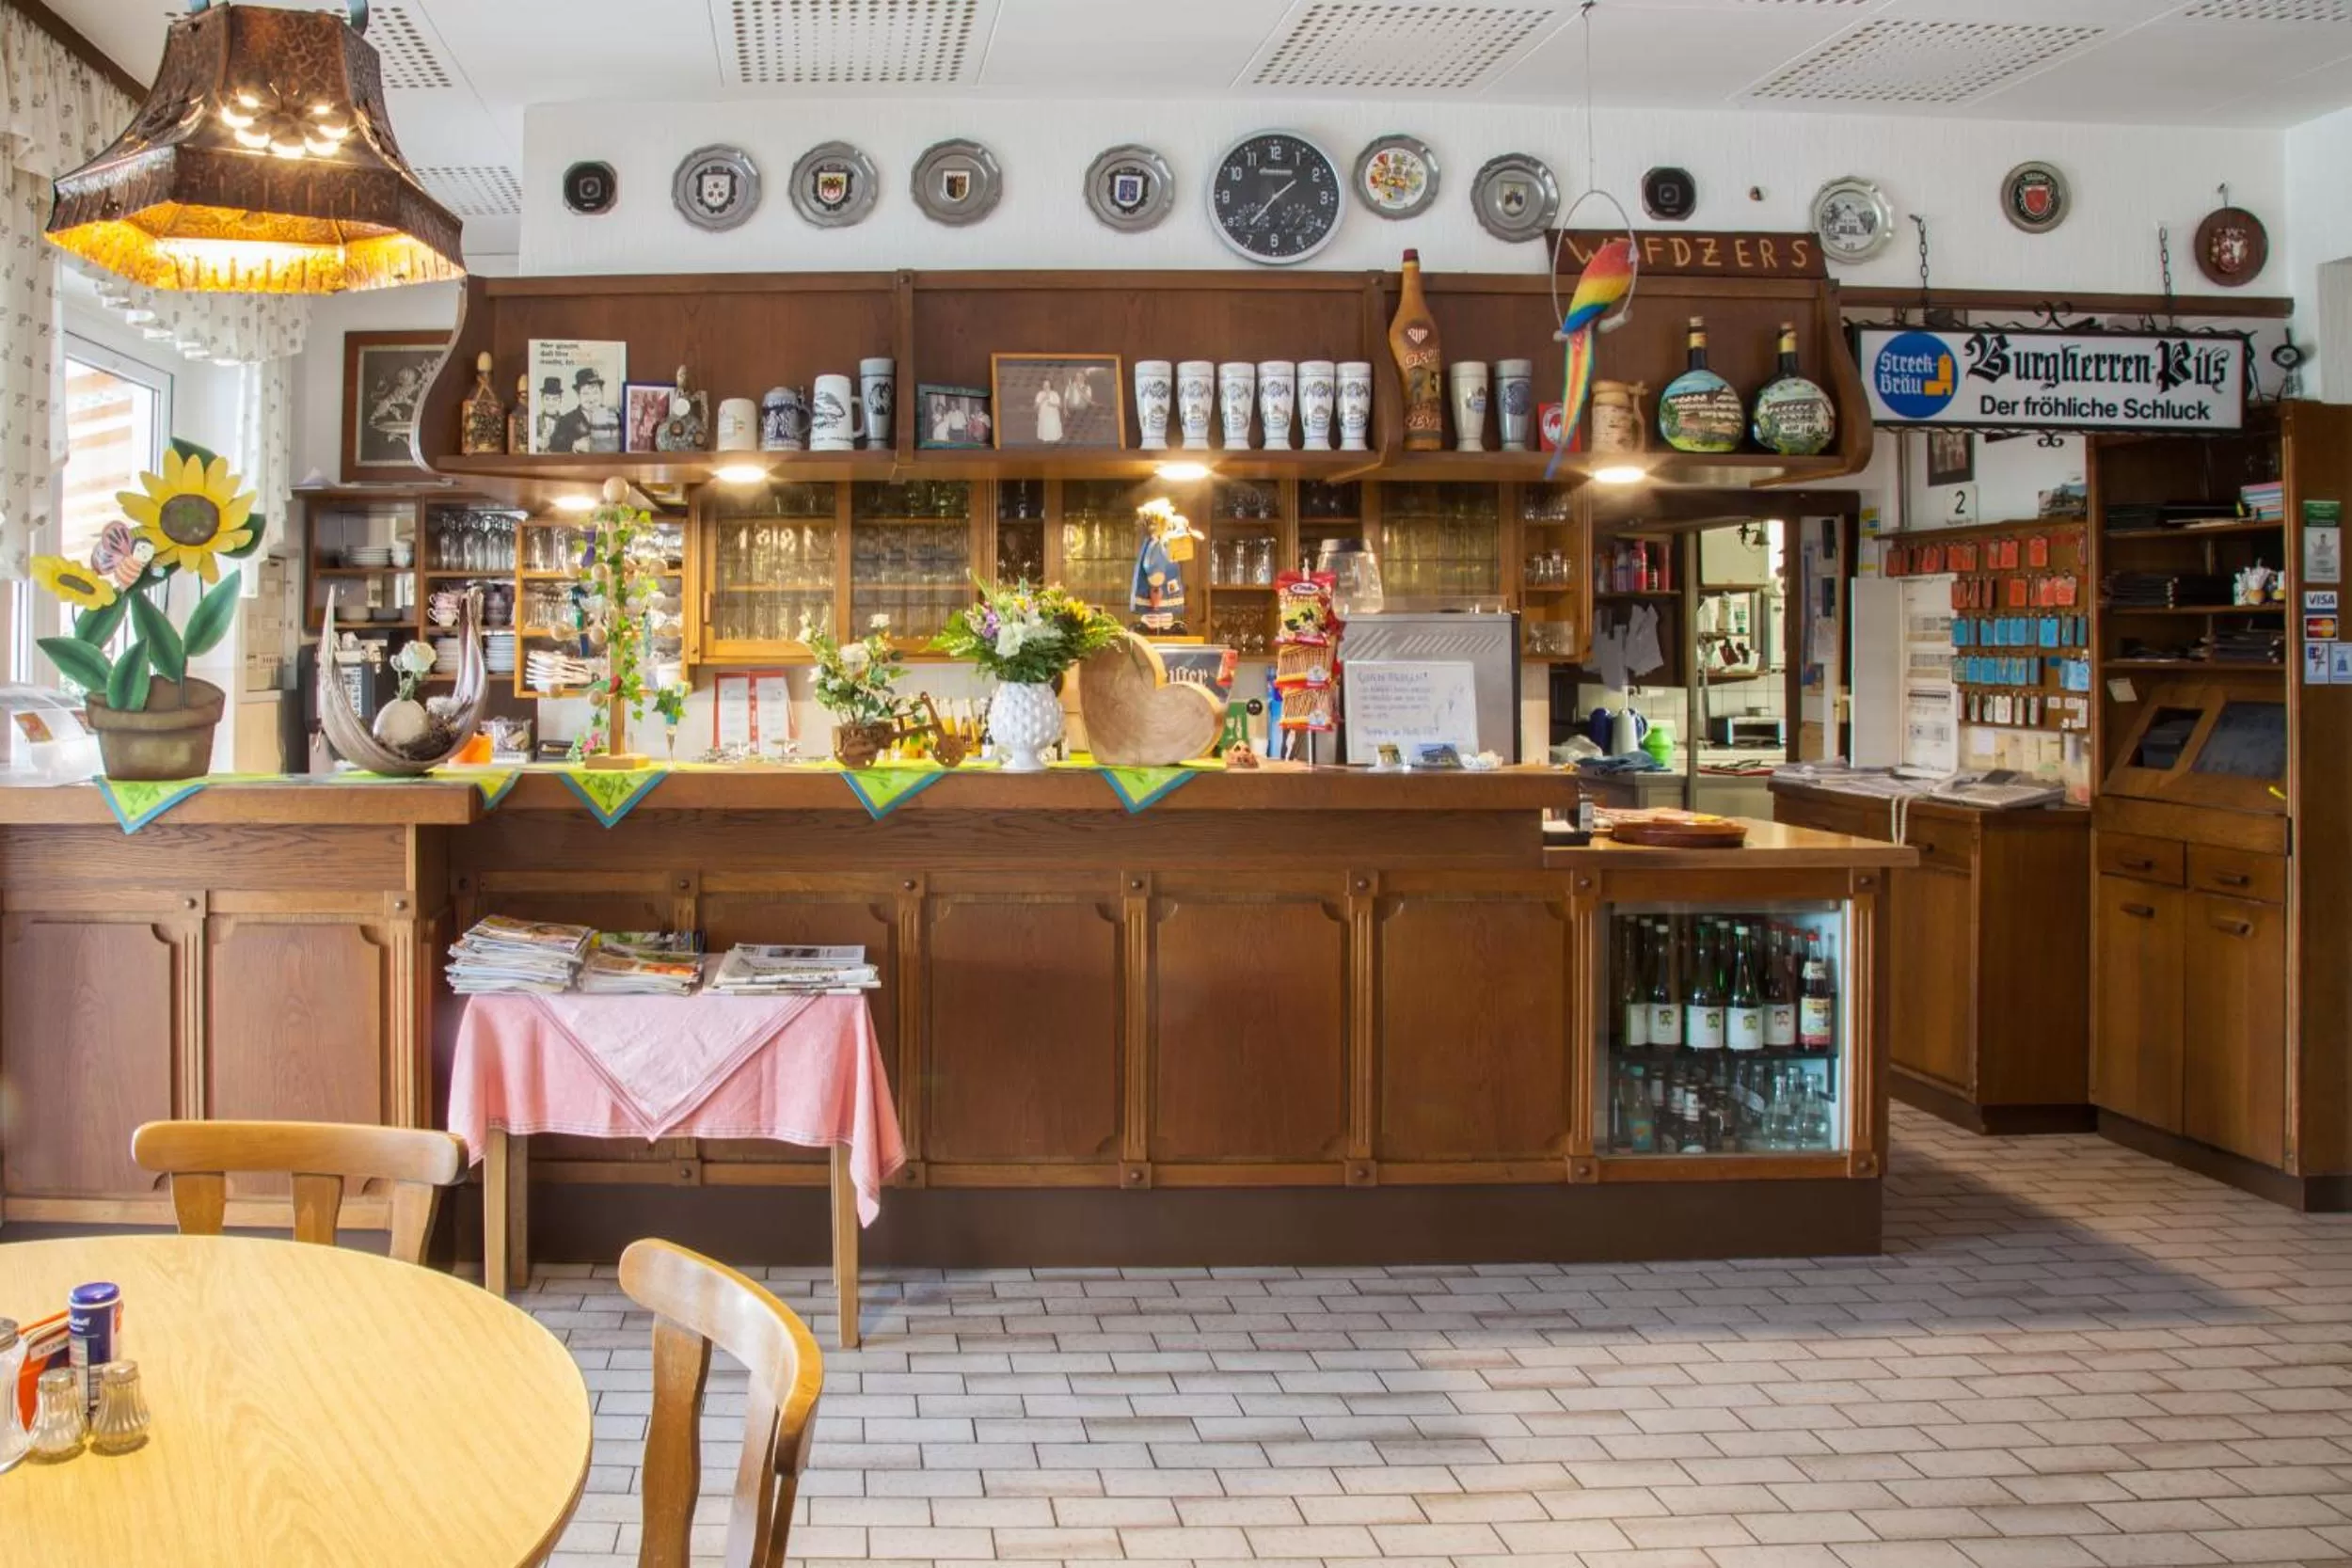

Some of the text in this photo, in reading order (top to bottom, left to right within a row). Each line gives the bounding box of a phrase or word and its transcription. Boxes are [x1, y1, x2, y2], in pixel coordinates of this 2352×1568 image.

[1247, 152, 1258, 166] 11
[1269, 145, 1281, 161] 12
[1231, 167, 1242, 181] 10
[1312, 167, 1320, 182] 2
[1320, 191, 1327, 204] 3
[1565, 236, 1808, 268] WFDZERS
[1880, 373, 1922, 395] Bräu
[1979, 395, 2211, 420] Der fröhliche Schluck
[1954, 490, 1966, 515] 2
[2308, 593, 2336, 606] VISA
